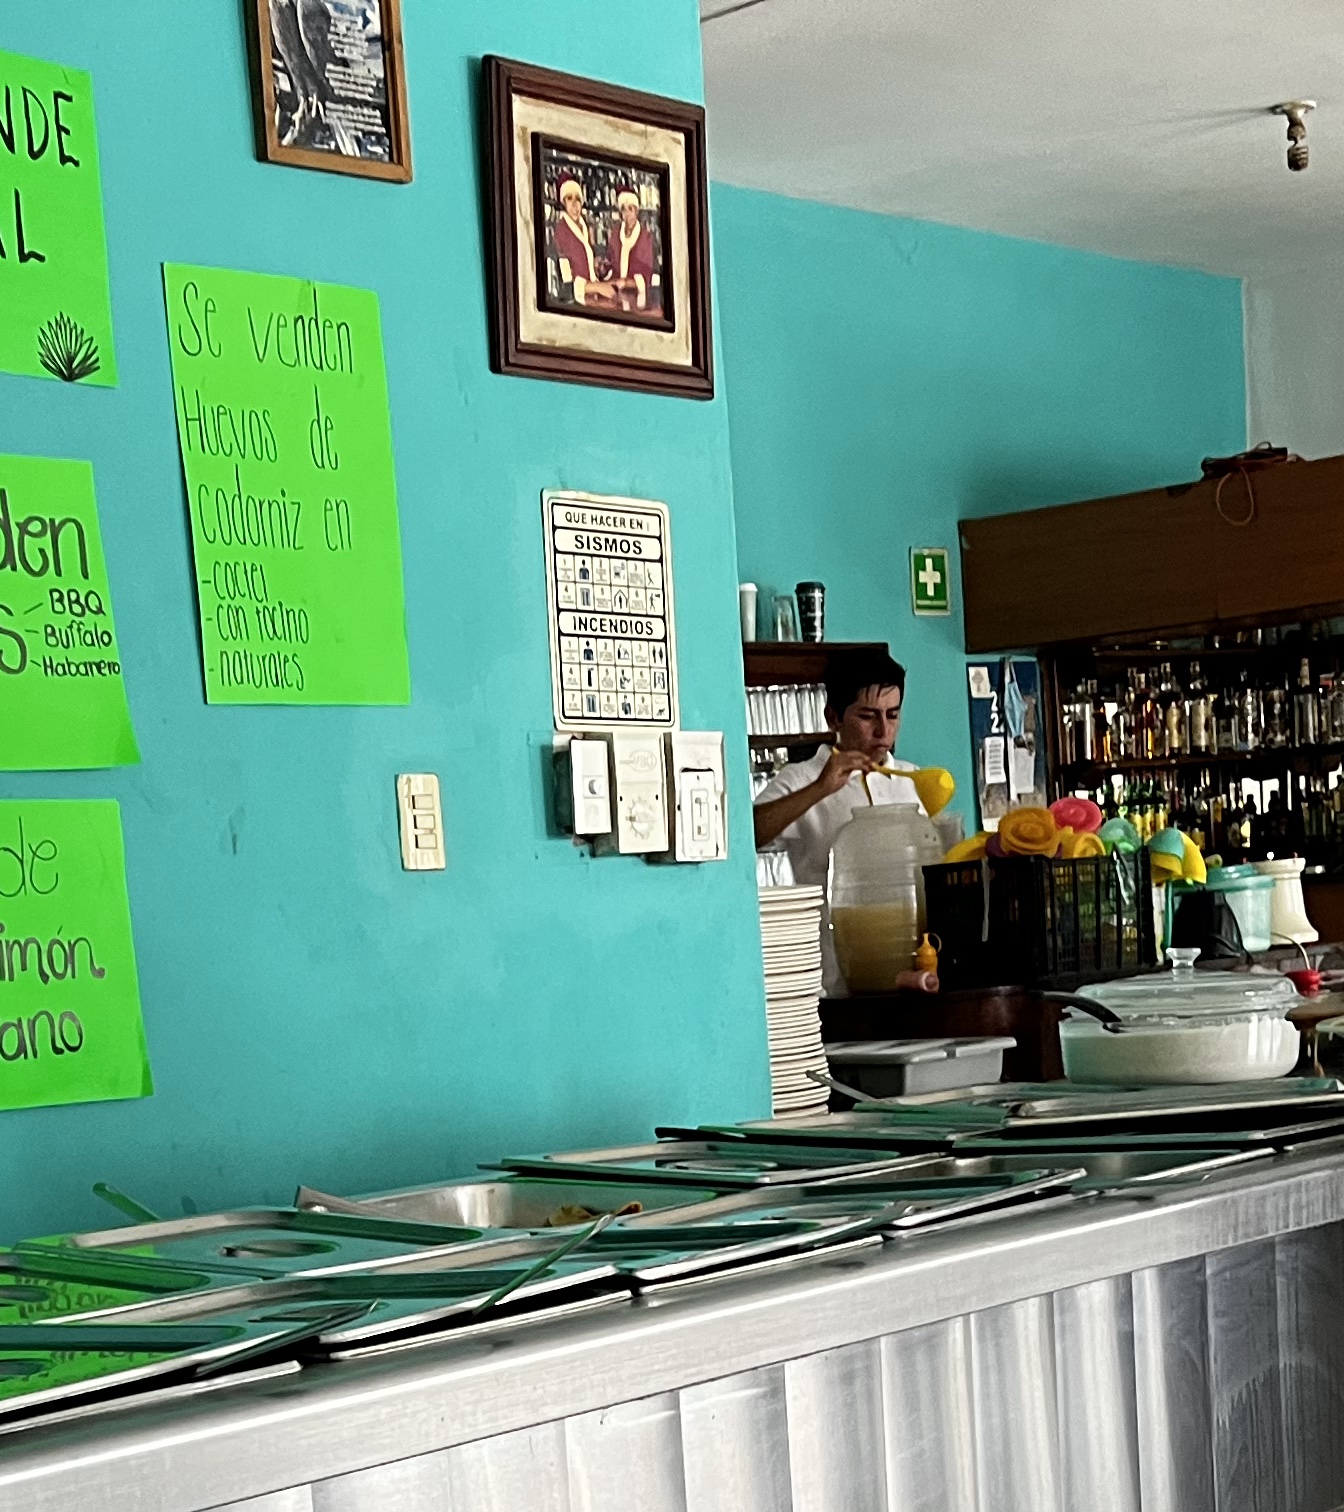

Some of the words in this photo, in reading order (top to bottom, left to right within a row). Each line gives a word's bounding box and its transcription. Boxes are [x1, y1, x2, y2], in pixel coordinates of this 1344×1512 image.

[178, 282, 222, 358] Se
[181, 385, 278, 463] Huevos
[309, 384, 339, 470] de
[323, 496, 353, 552] en
[565, 512, 587, 524] QUE
[591, 514, 626, 528] HACER
[629, 518, 643, 529] EN
[574, 534, 643, 555] SISMOS
[49, 588, 107, 618] BBQ
[44, 620, 113, 649] Buffalo
[256, 601, 309, 644] tocino
[573, 616, 653, 635] INCENDIOS
